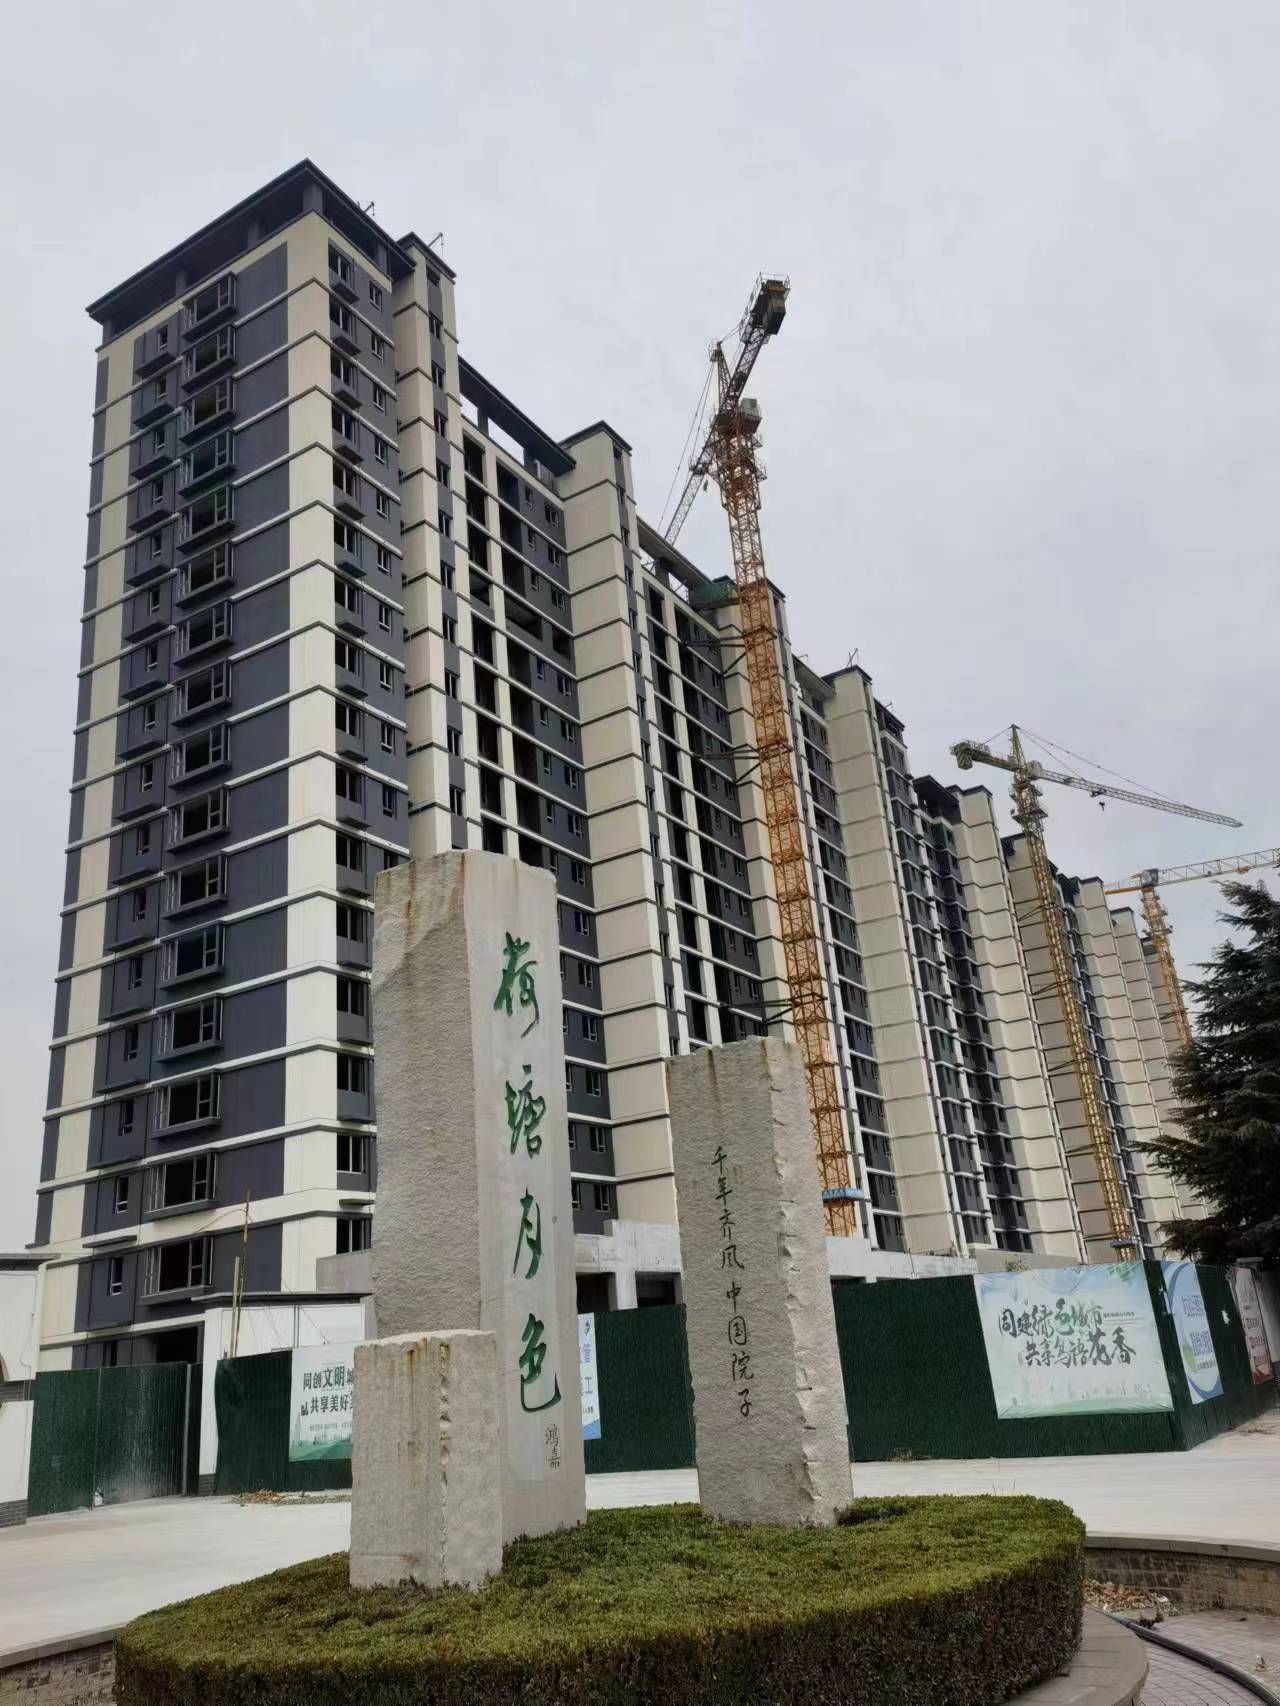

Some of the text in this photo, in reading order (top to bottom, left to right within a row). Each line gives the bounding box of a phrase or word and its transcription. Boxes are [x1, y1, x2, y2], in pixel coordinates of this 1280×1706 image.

[493, 931, 562, 1413] 荷塘月色
[711, 1145, 753, 1417] 千年齐风中国院子
[998, 1298, 1103, 1338] 同建绿色城市
[1025, 1326, 1137, 1368] 共享鸟语花香
